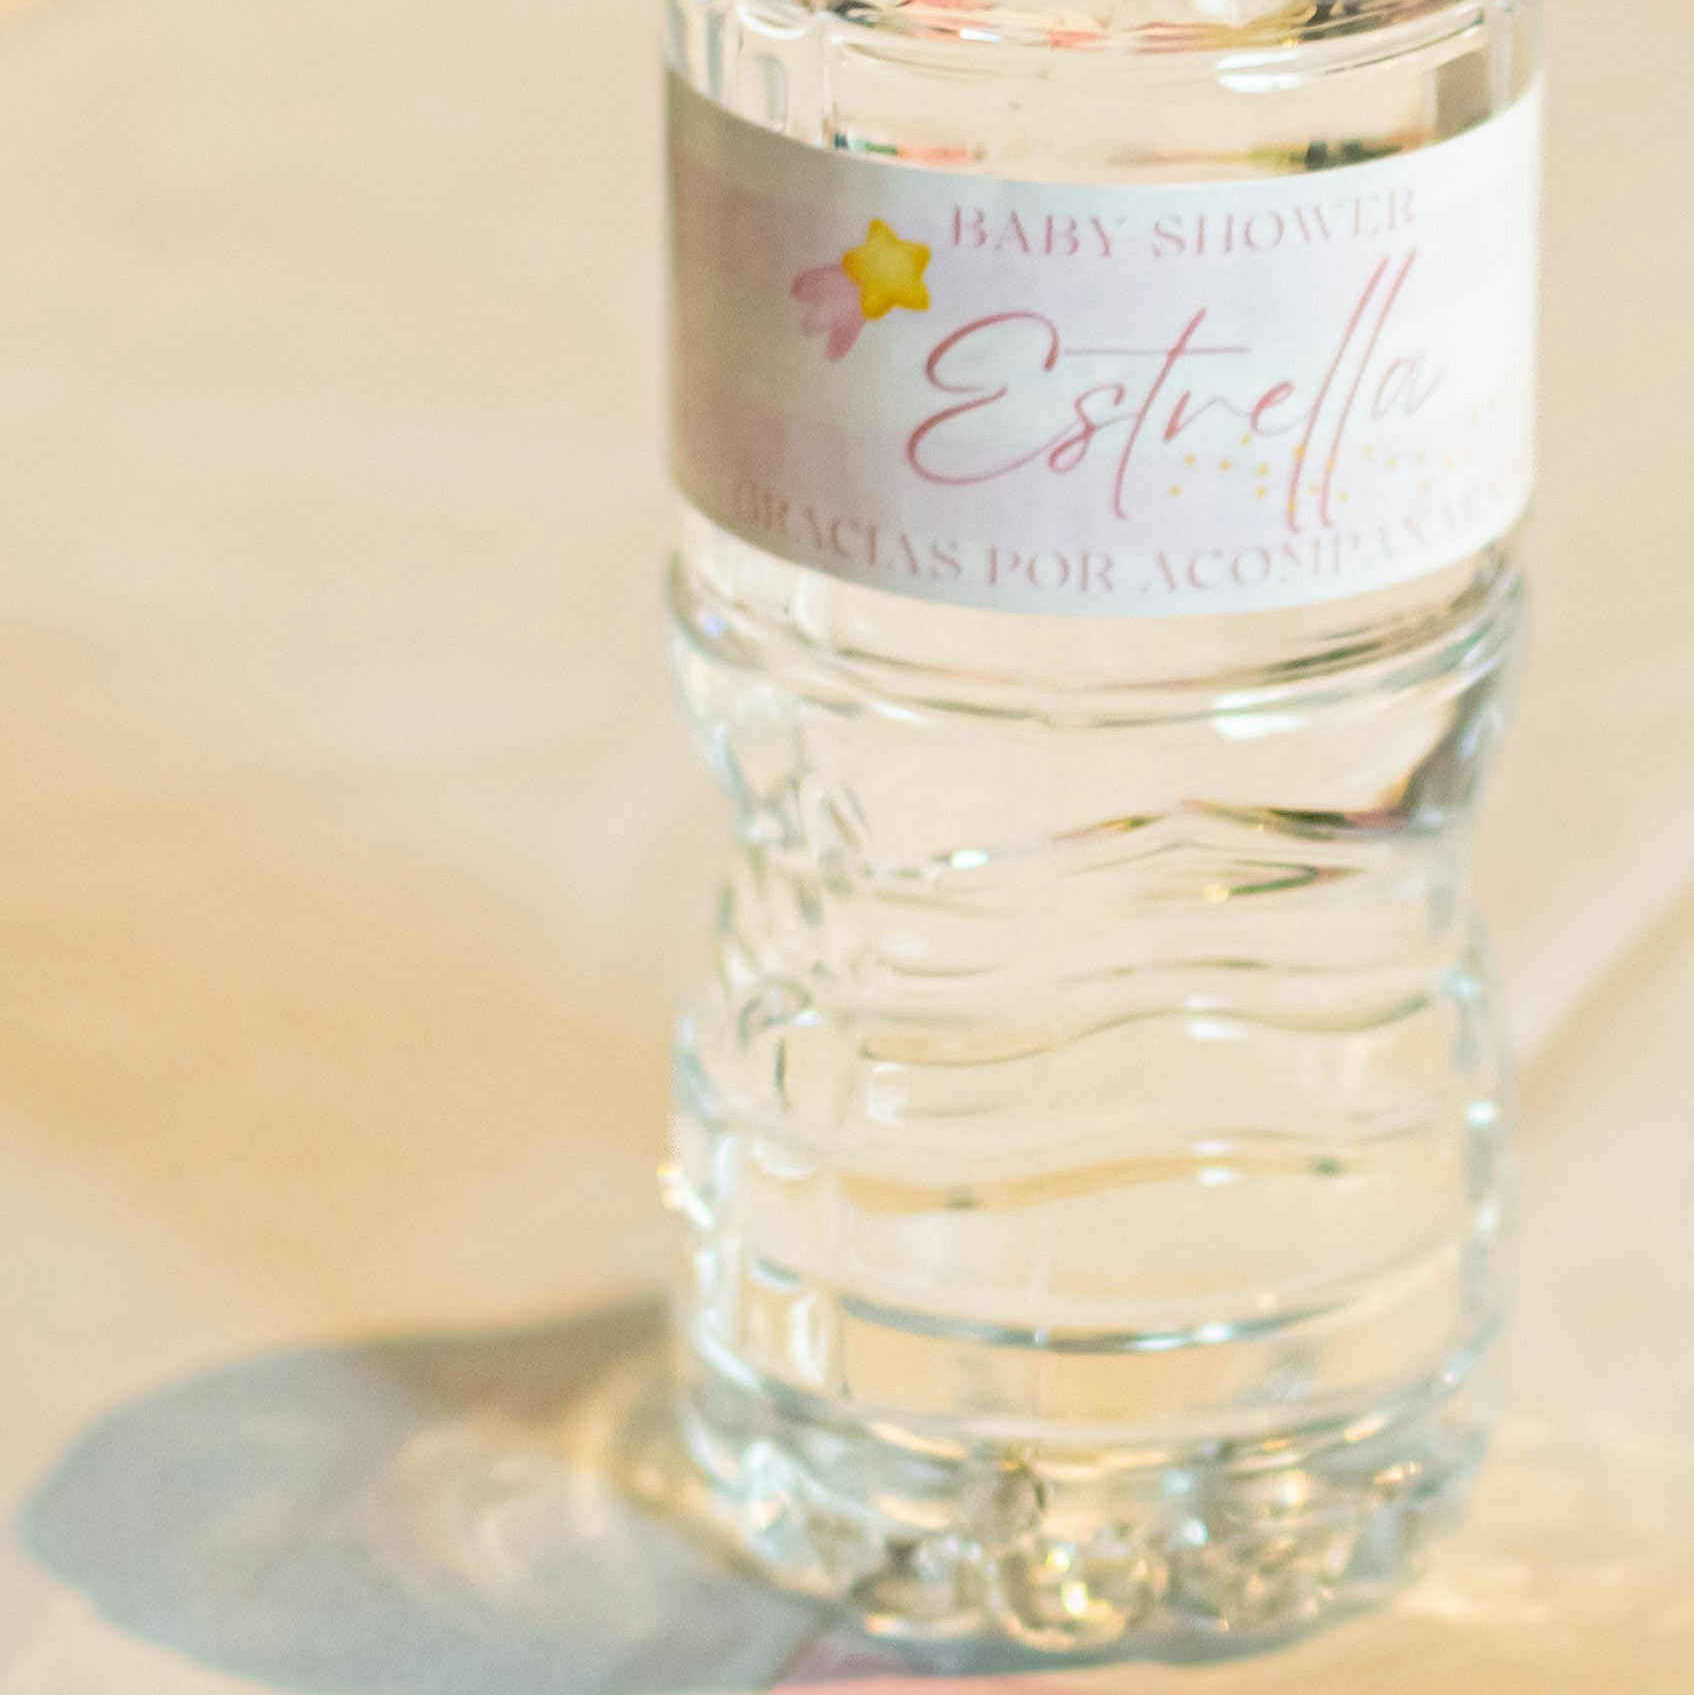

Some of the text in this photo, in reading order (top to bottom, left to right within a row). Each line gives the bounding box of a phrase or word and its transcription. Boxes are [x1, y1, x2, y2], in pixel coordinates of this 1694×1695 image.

[951, 186, 1418, 261] BABY SHOWER
[905, 247, 1448, 536] Estrella
[987, 545, 1114, 593] POR
